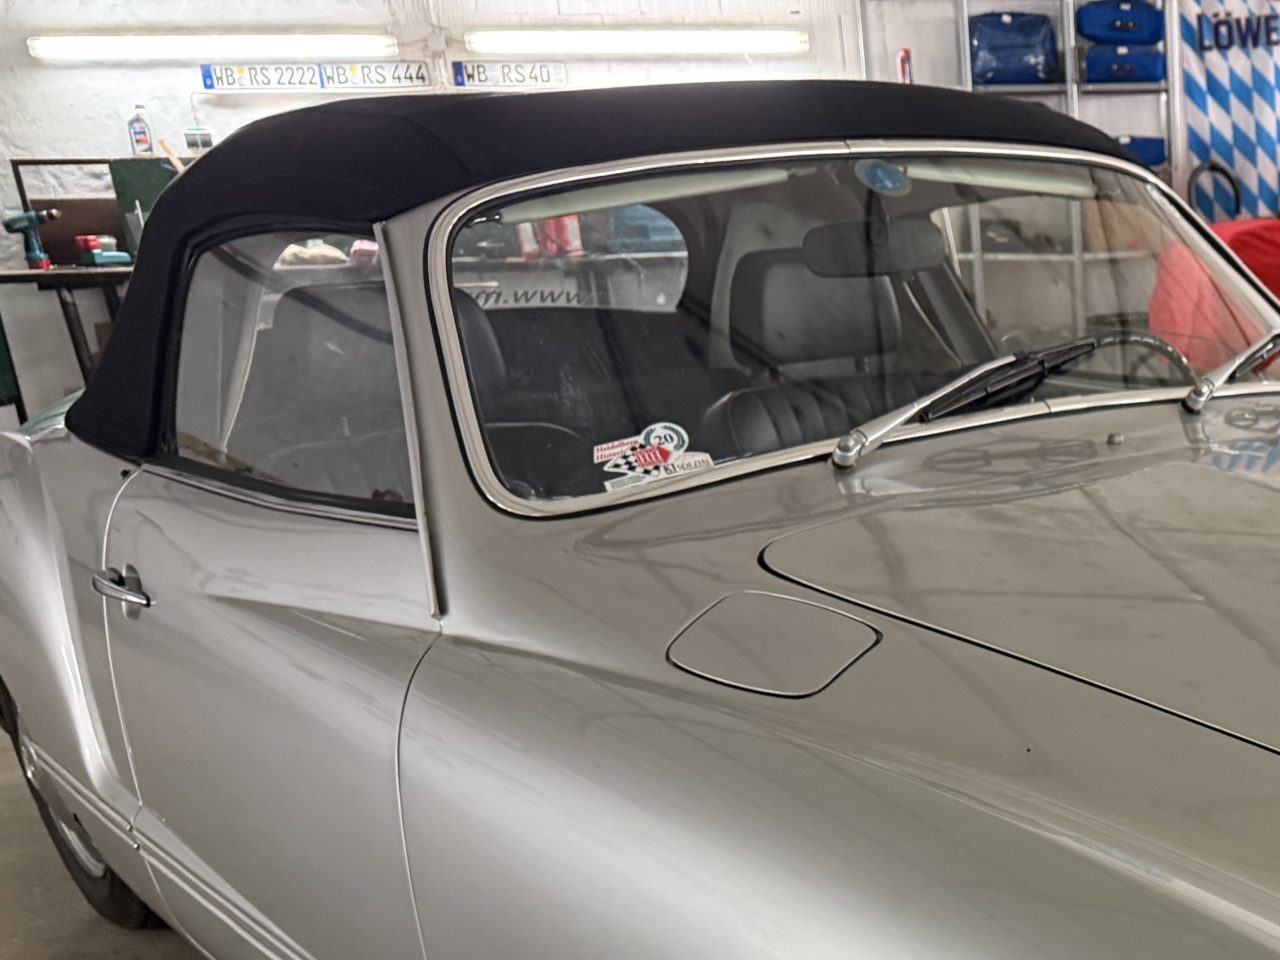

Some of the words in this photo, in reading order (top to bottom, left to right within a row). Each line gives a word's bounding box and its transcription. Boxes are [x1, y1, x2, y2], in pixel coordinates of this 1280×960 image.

[213, 66, 236, 86] WB
[248, 66, 271, 86] RS
[275, 66, 318, 86] 2222
[324, 65, 348, 85] WB
[361, 64, 386, 84] RS
[392, 64, 426, 83] 444
[464, 64, 488, 83] WB
[654, 432, 674, 446] 20
